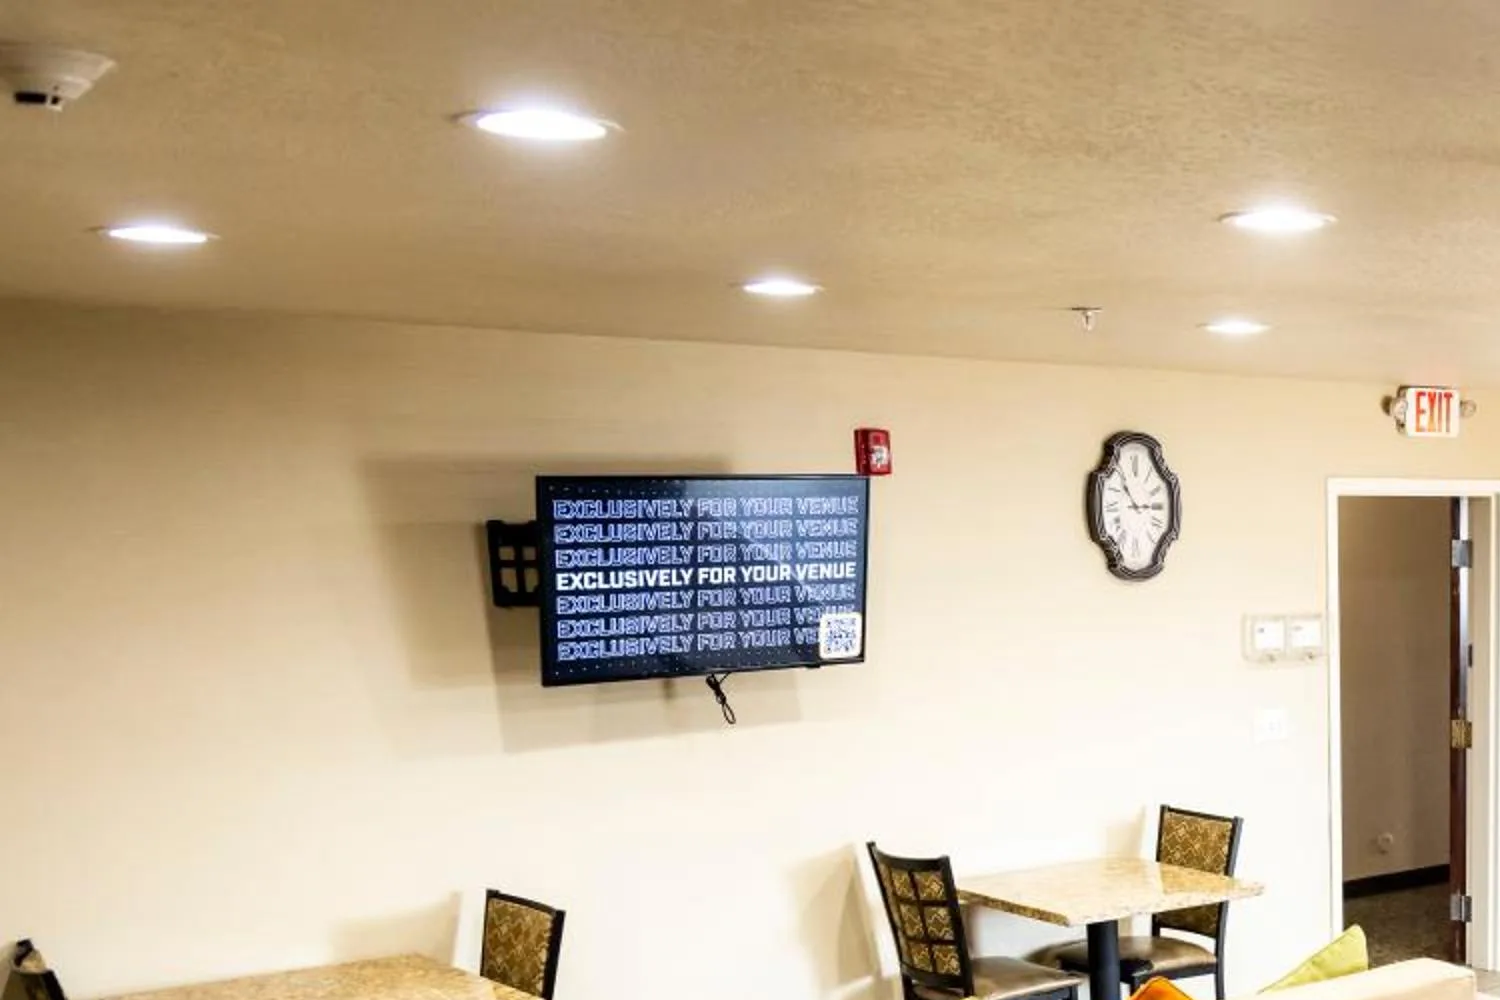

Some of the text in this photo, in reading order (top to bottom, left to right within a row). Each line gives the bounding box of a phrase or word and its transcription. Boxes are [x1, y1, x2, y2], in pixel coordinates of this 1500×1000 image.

[1415, 391, 1453, 433] EXIT
[553, 496, 859, 519] EXCLUSIVELY FOR YOUR VENUE
[554, 517, 858, 544] EXCLUSIVELY FOR YOUR VENUE
[555, 540, 857, 568] EXCLUSIVELY FOR YOUR VENUE
[556, 562, 857, 591] EXCLUSIVELY FOR YOUR VENUE
[557, 583, 857, 615] EXCLUSIVELY FOR YOUR VENUE
[557, 613, 694, 639] EXCLUSIVELY
[697, 611, 736, 630] FOR
[739, 608, 791, 627] YOUR
[557, 634, 694, 661] EXCLUSIVELY
[697, 631, 736, 651] FOR
[739, 629, 791, 647] YOUR
